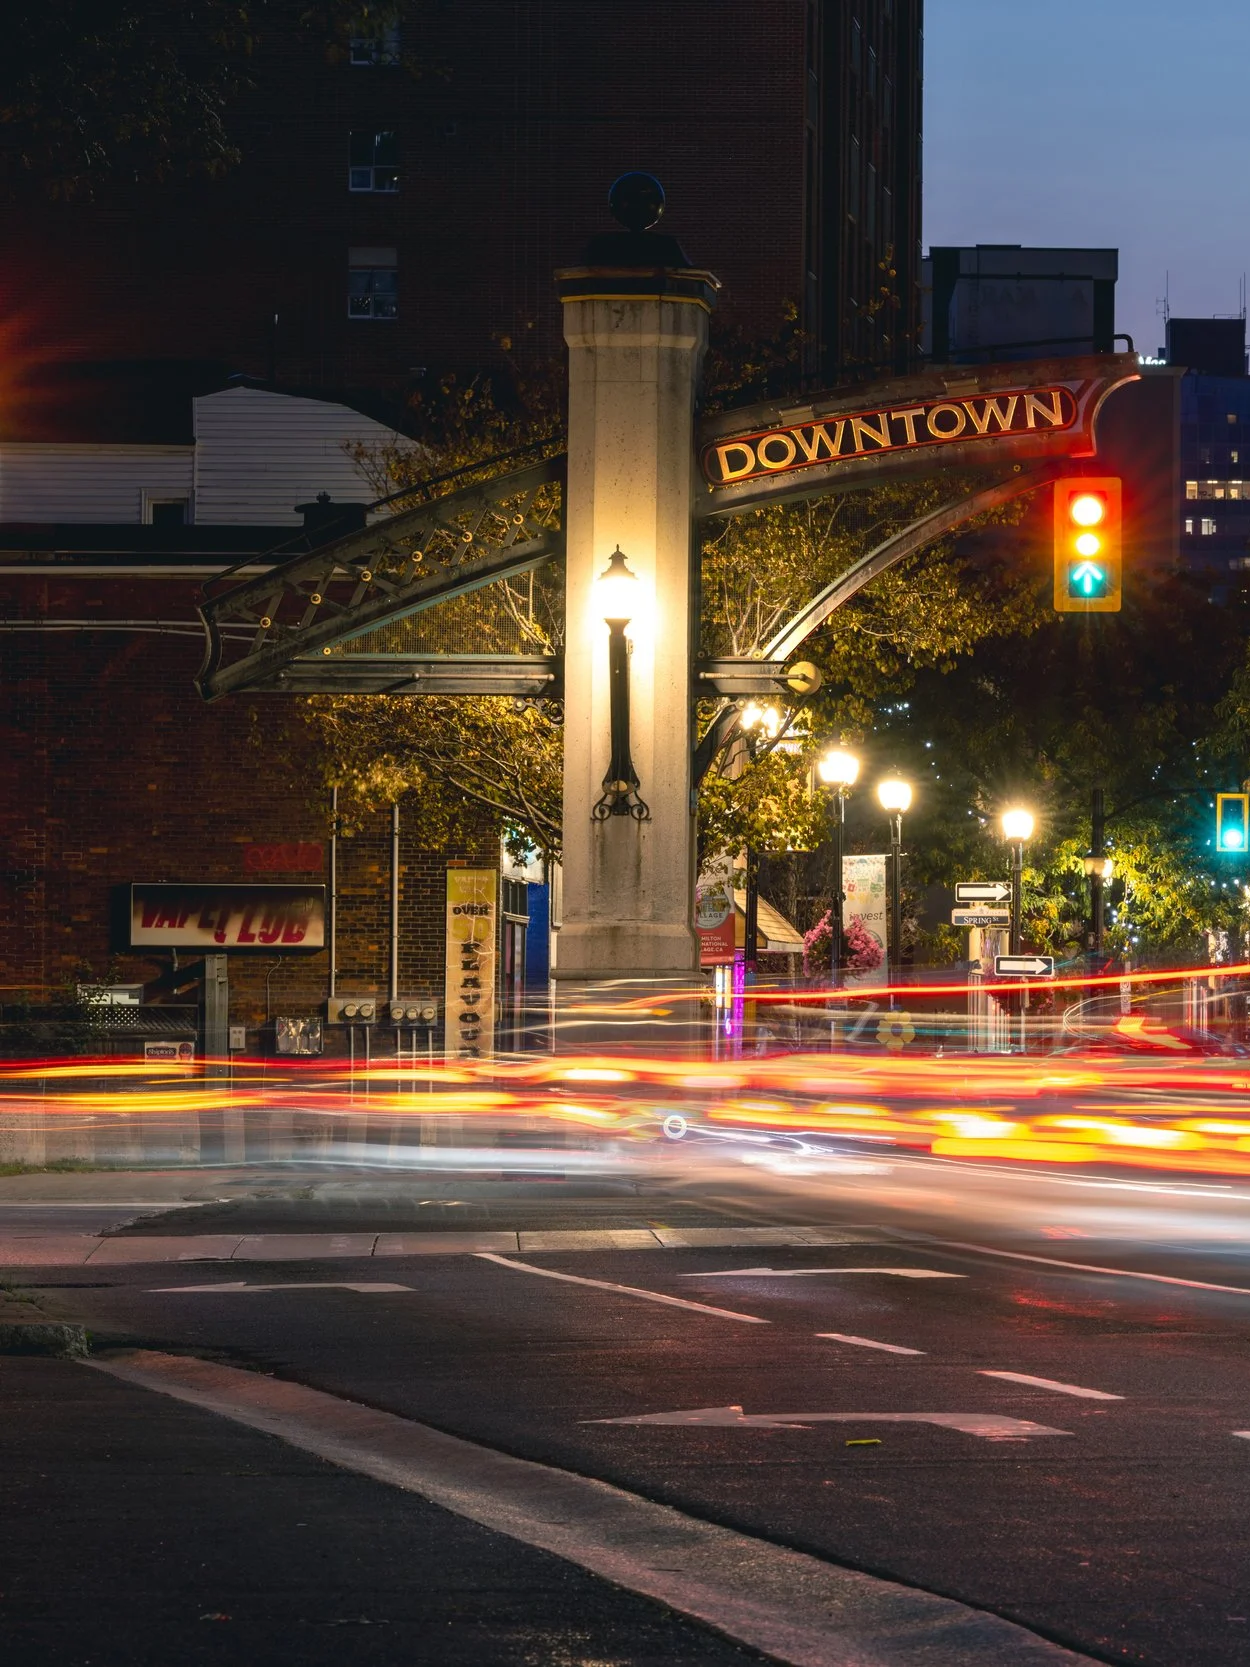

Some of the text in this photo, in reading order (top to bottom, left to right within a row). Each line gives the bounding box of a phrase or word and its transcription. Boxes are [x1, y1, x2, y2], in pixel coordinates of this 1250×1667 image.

[715, 391, 1064, 481] DOWNTOWN
[452, 903, 489, 916] OVER
[849, 911, 884, 921] invest
[963, 916, 992, 925] SPRING
